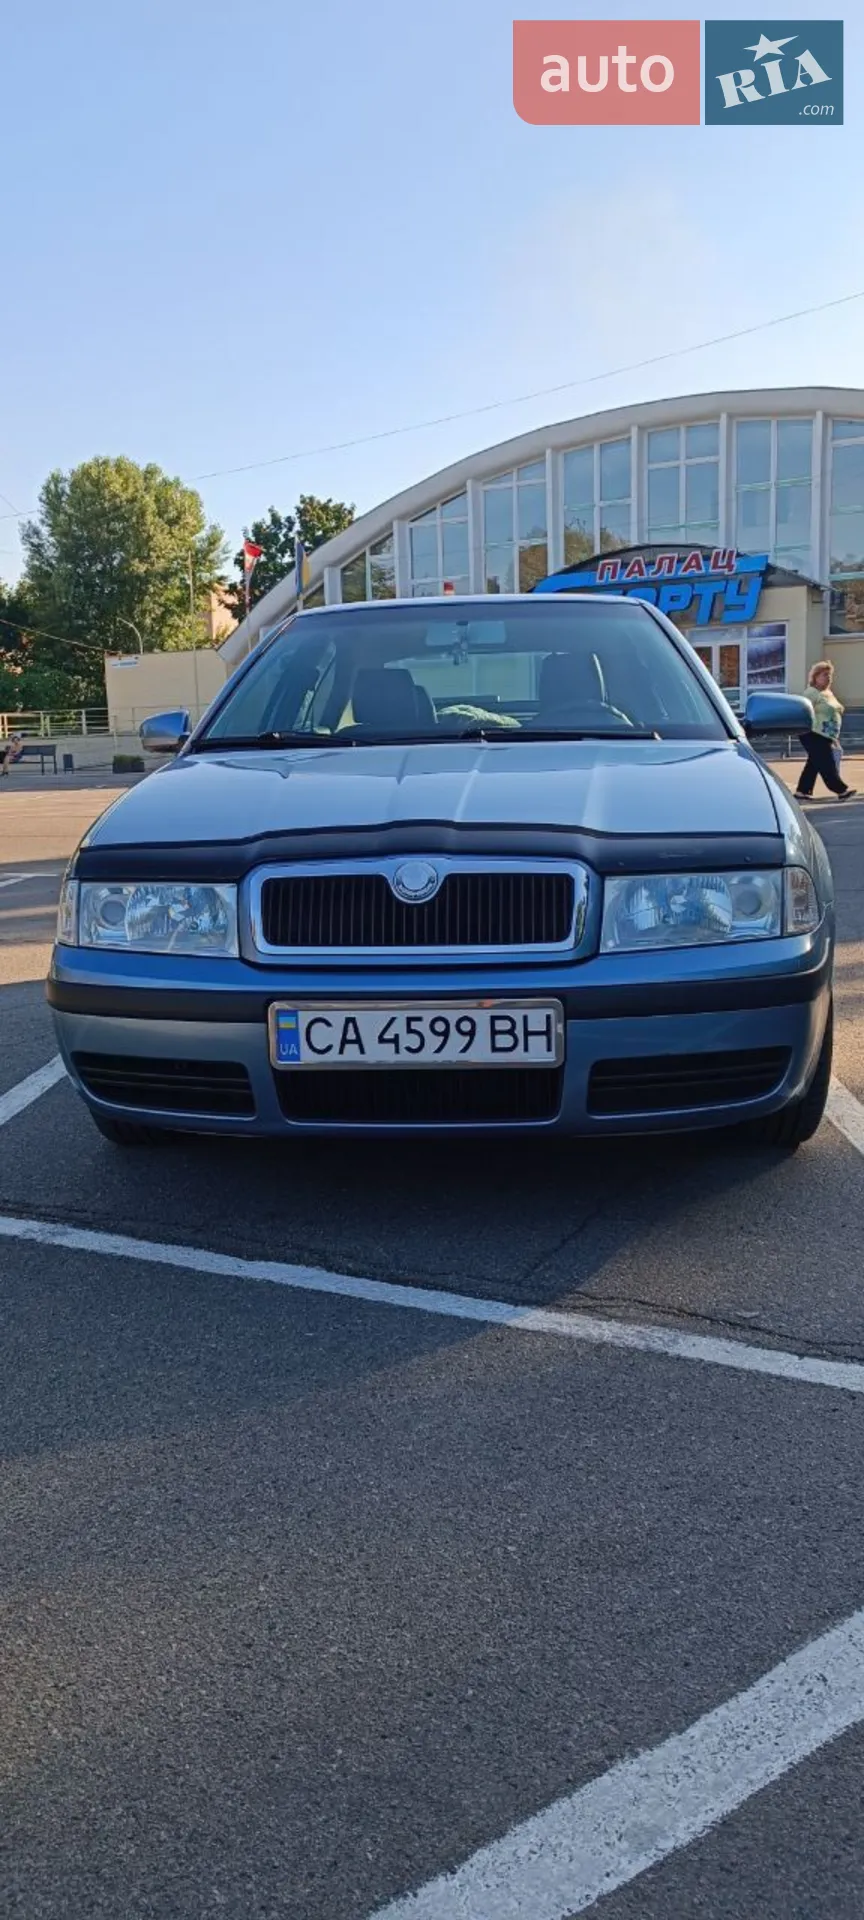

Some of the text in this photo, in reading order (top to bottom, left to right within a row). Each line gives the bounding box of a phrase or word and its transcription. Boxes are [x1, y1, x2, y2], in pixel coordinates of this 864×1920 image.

[596, 547, 737, 583] ПАЛАЦ
[280, 1043, 299, 1056] UA
[305, 1013, 552, 1056] CA 4599 BH
